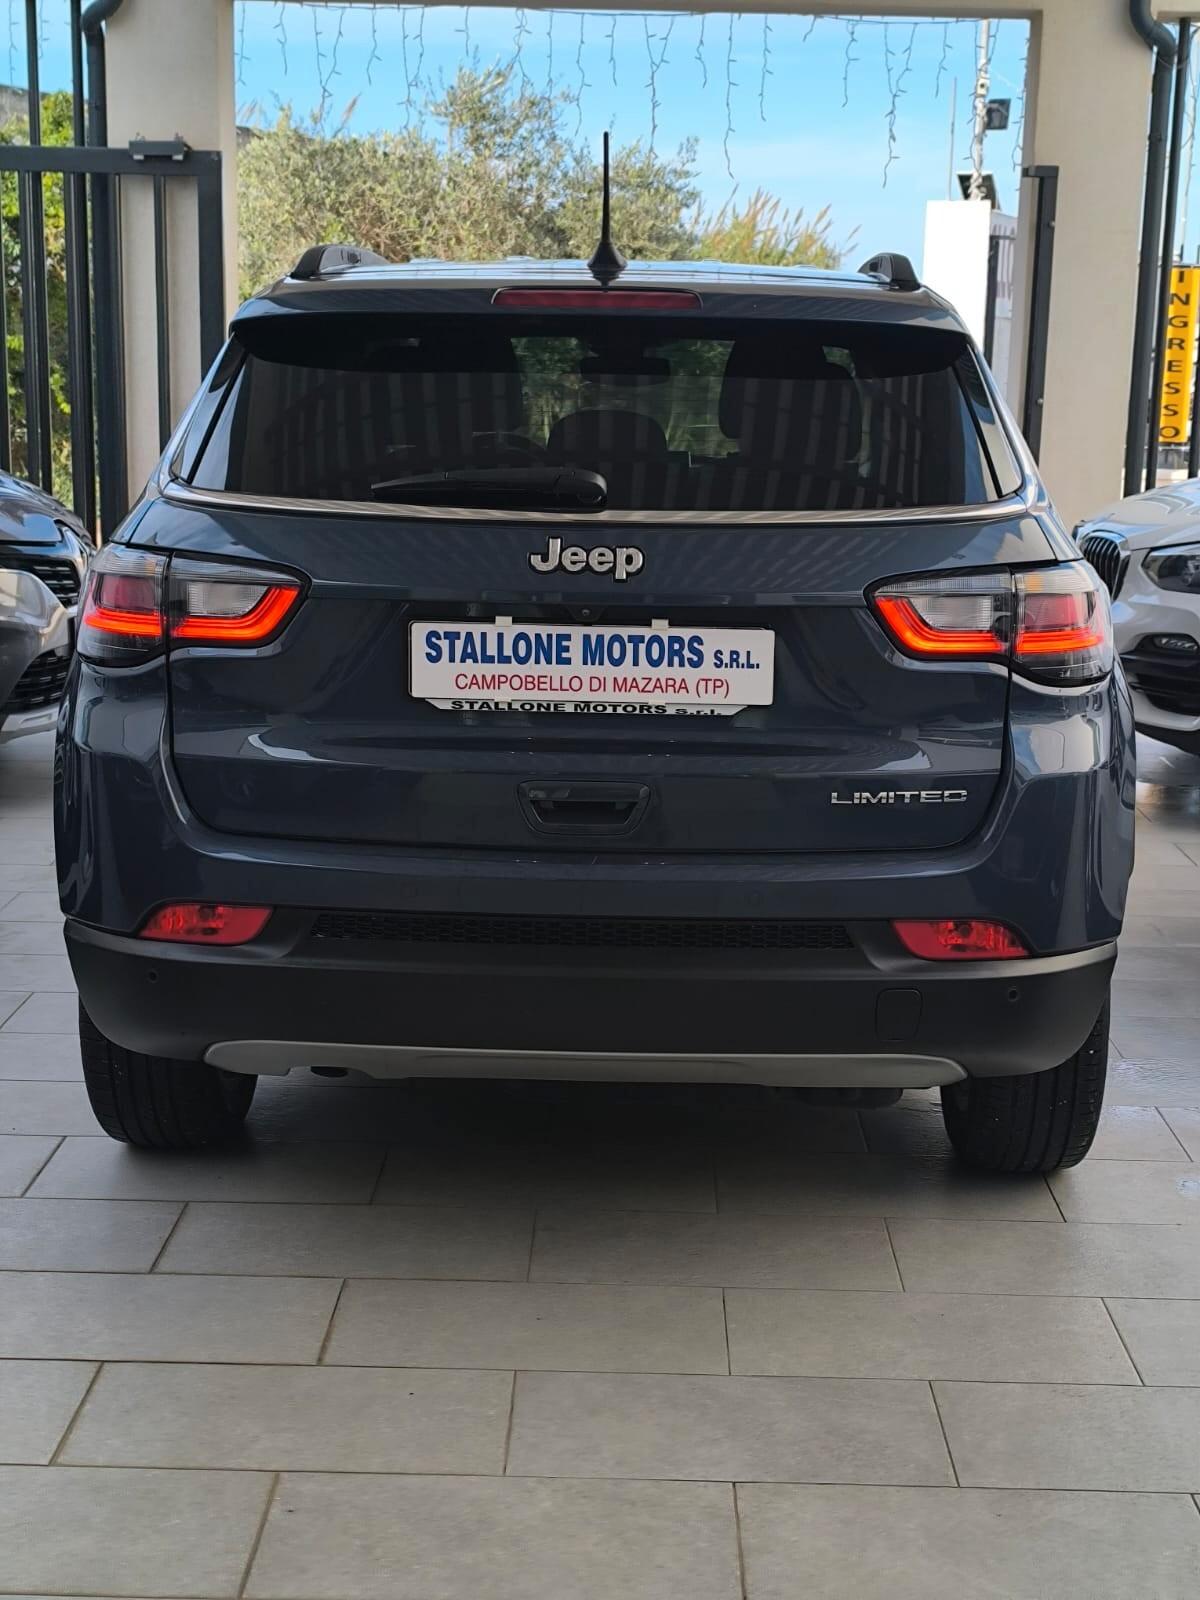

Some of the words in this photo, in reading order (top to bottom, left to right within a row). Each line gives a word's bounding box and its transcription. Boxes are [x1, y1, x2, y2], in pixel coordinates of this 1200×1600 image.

[1159, 270, 1190, 439] INGRESSO
[529, 537, 644, 580] Jeep
[425, 630, 572, 666] STALLONE
[582, 634, 705, 669] MOTORS
[713, 649, 760, 670] S.R.L.
[454, 673, 583, 694] CAMPOBELLO
[590, 677, 606, 693] DI
[613, 677, 689, 695] MAZARA
[695, 678, 730, 699] (TP)
[451, 700, 566, 712] STALLONE
[573, 703, 667, 714] MOTORS
[831, 790, 968, 804] LIMITED
